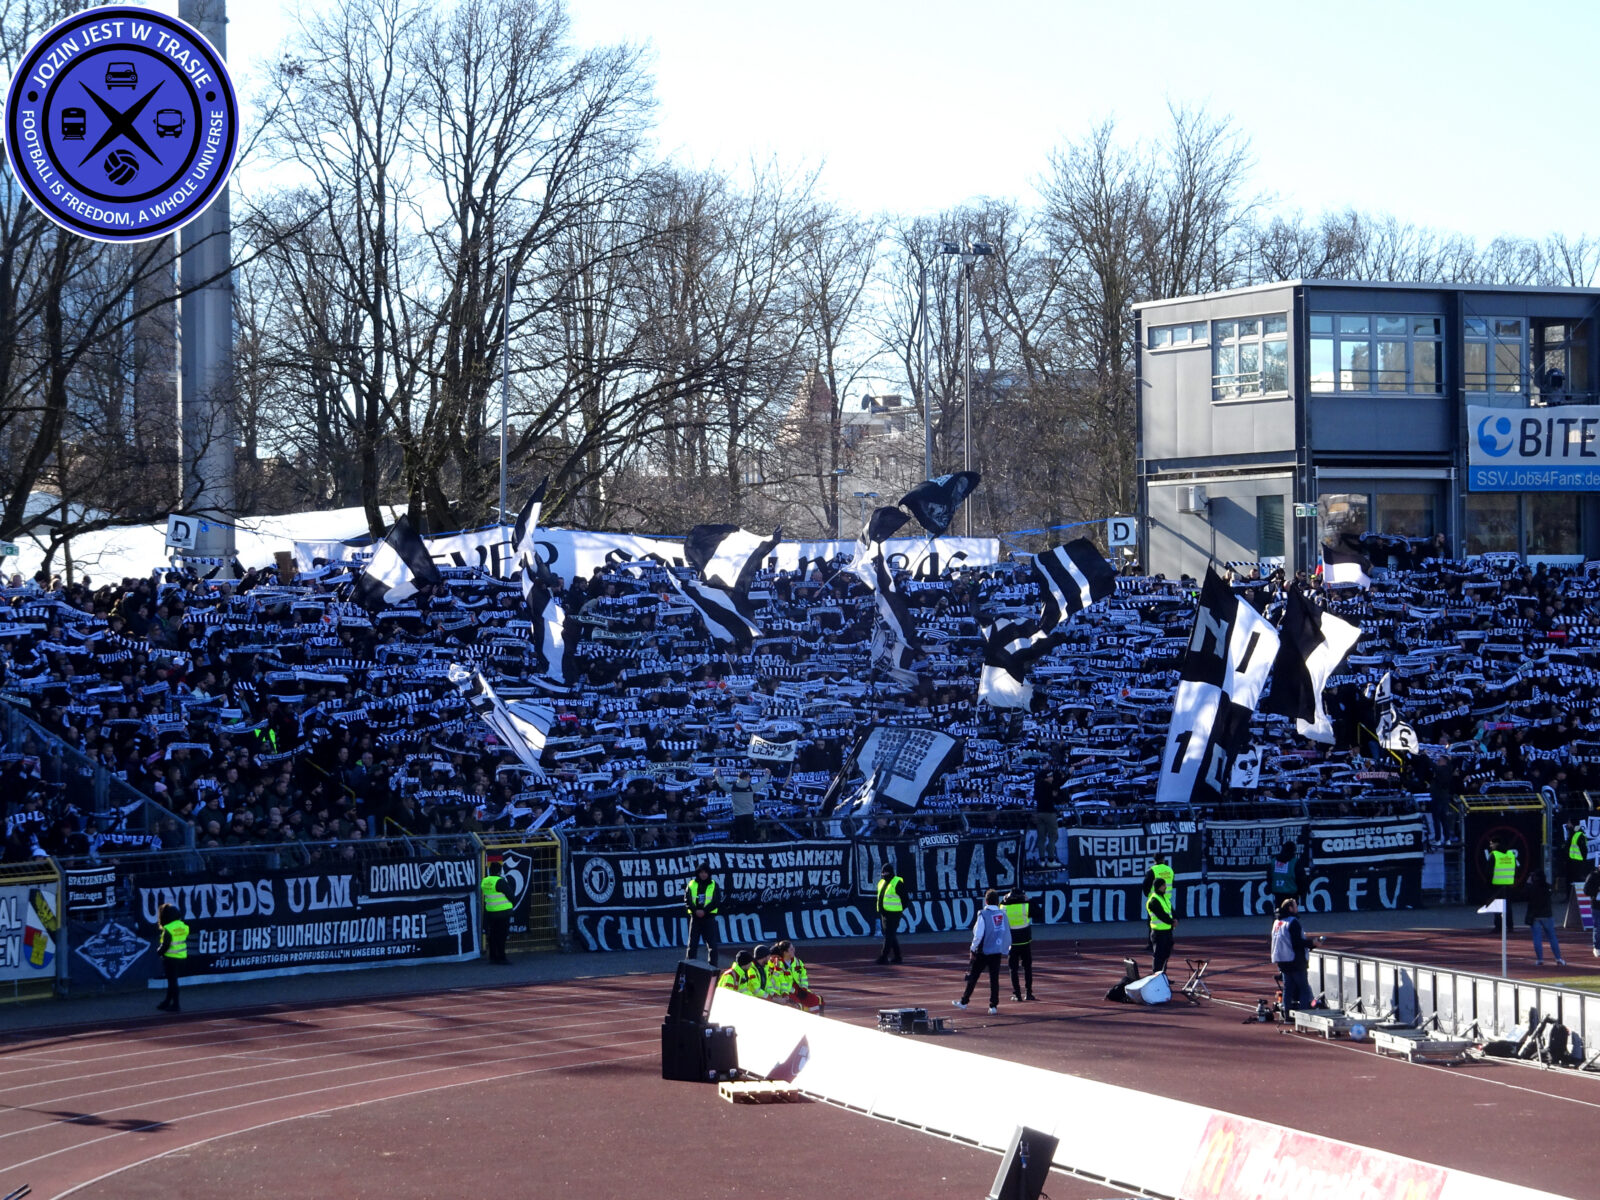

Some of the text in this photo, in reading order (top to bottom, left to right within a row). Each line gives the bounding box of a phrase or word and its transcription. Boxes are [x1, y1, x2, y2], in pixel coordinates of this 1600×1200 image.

[1519, 418, 1600, 458] BITE
[1114, 523, 1129, 541] D
[919, 834, 959, 848] PRODIGYS
[1079, 835, 1188, 856] NEBULOSA
[1321, 832, 1414, 852] constante
[370, 862, 420, 892] DONAU
[436, 859, 475, 887] CREW
[619, 850, 844, 877] WIR HALTEN FEST ZUSAMMEN
[1096, 856, 1173, 877] IMPE
[623, 880, 658, 899] UND
[663, 873, 726, 897] GEN
[733, 871, 804, 890] UNSEREN
[807, 870, 842, 885] WEG
[1240, 876, 1332, 917] 186
[139, 879, 275, 923] UNITEDS
[284, 875, 353, 913] ULM
[199, 929, 236, 954] GEBT
[242, 926, 272, 951] DAS
[277, 917, 385, 948] DONAUSTADION
[392, 914, 427, 939] FREI
